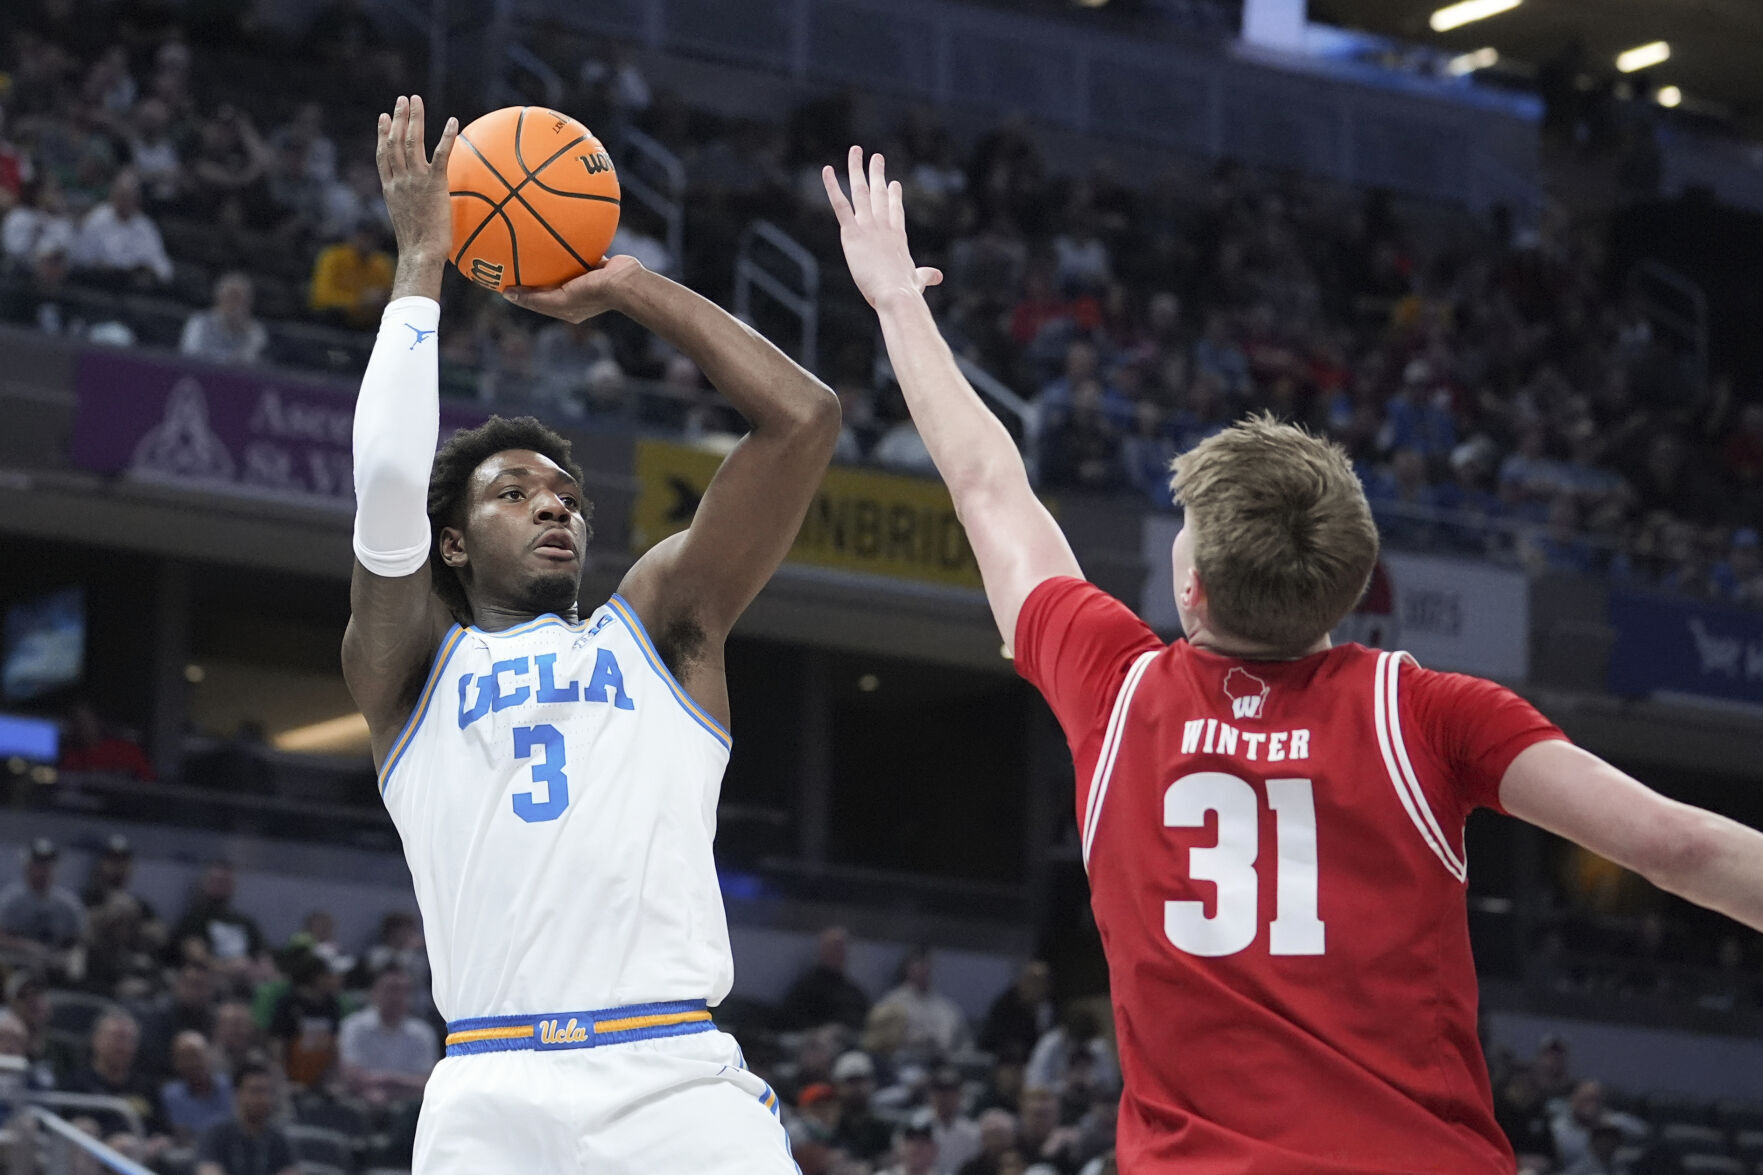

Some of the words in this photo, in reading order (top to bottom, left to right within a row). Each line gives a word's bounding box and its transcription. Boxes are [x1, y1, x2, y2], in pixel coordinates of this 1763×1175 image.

[458, 647, 635, 730] UCLA
[1232, 696, 1261, 720] W
[1181, 718, 1310, 762] WINTER
[512, 723, 569, 823] 3
[1163, 771, 1325, 957] 31
[539, 1018, 588, 1044] Ucla
